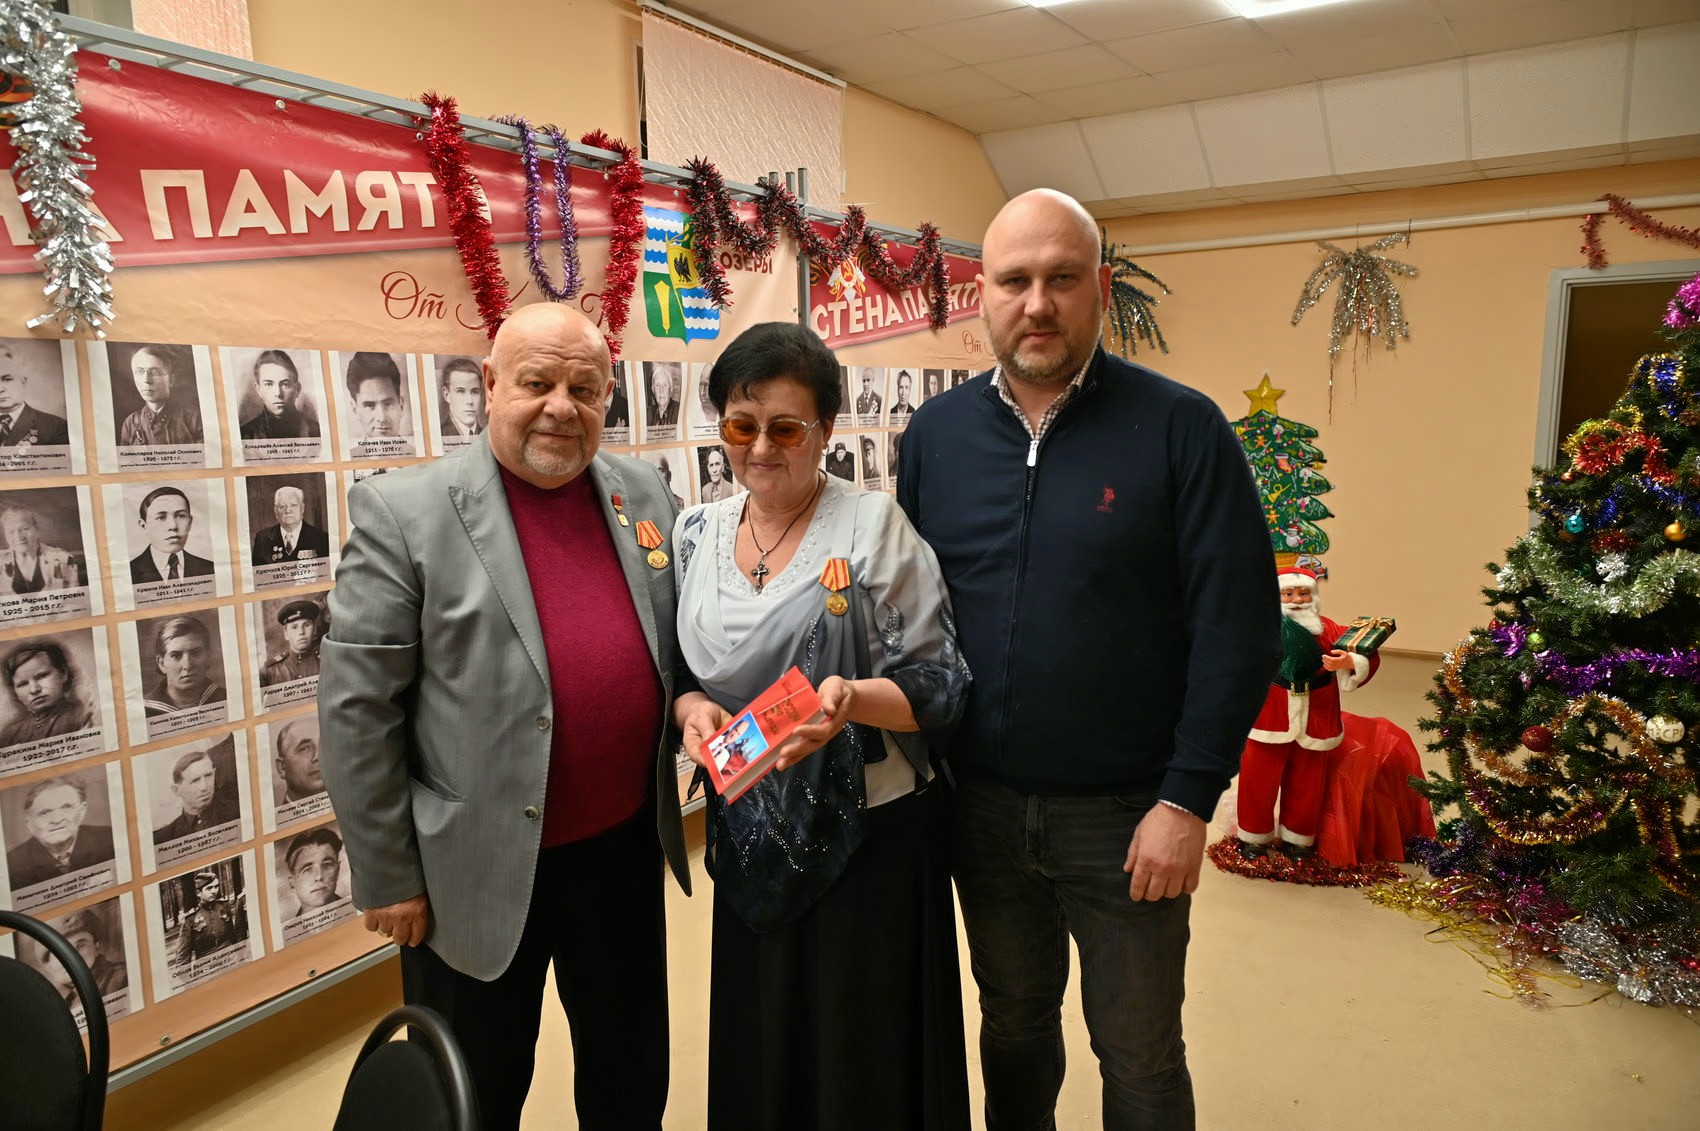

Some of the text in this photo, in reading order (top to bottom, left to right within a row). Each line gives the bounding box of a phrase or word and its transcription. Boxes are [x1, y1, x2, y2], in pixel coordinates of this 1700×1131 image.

[810, 281, 980, 341] СТЕНА ПАЯТ
[22, 596, 47, 605] Мария
[49, 591, 85, 601] Петровна
[38, 739, 64, 749] Мария
[65, 730, 101, 742] Ивановна
